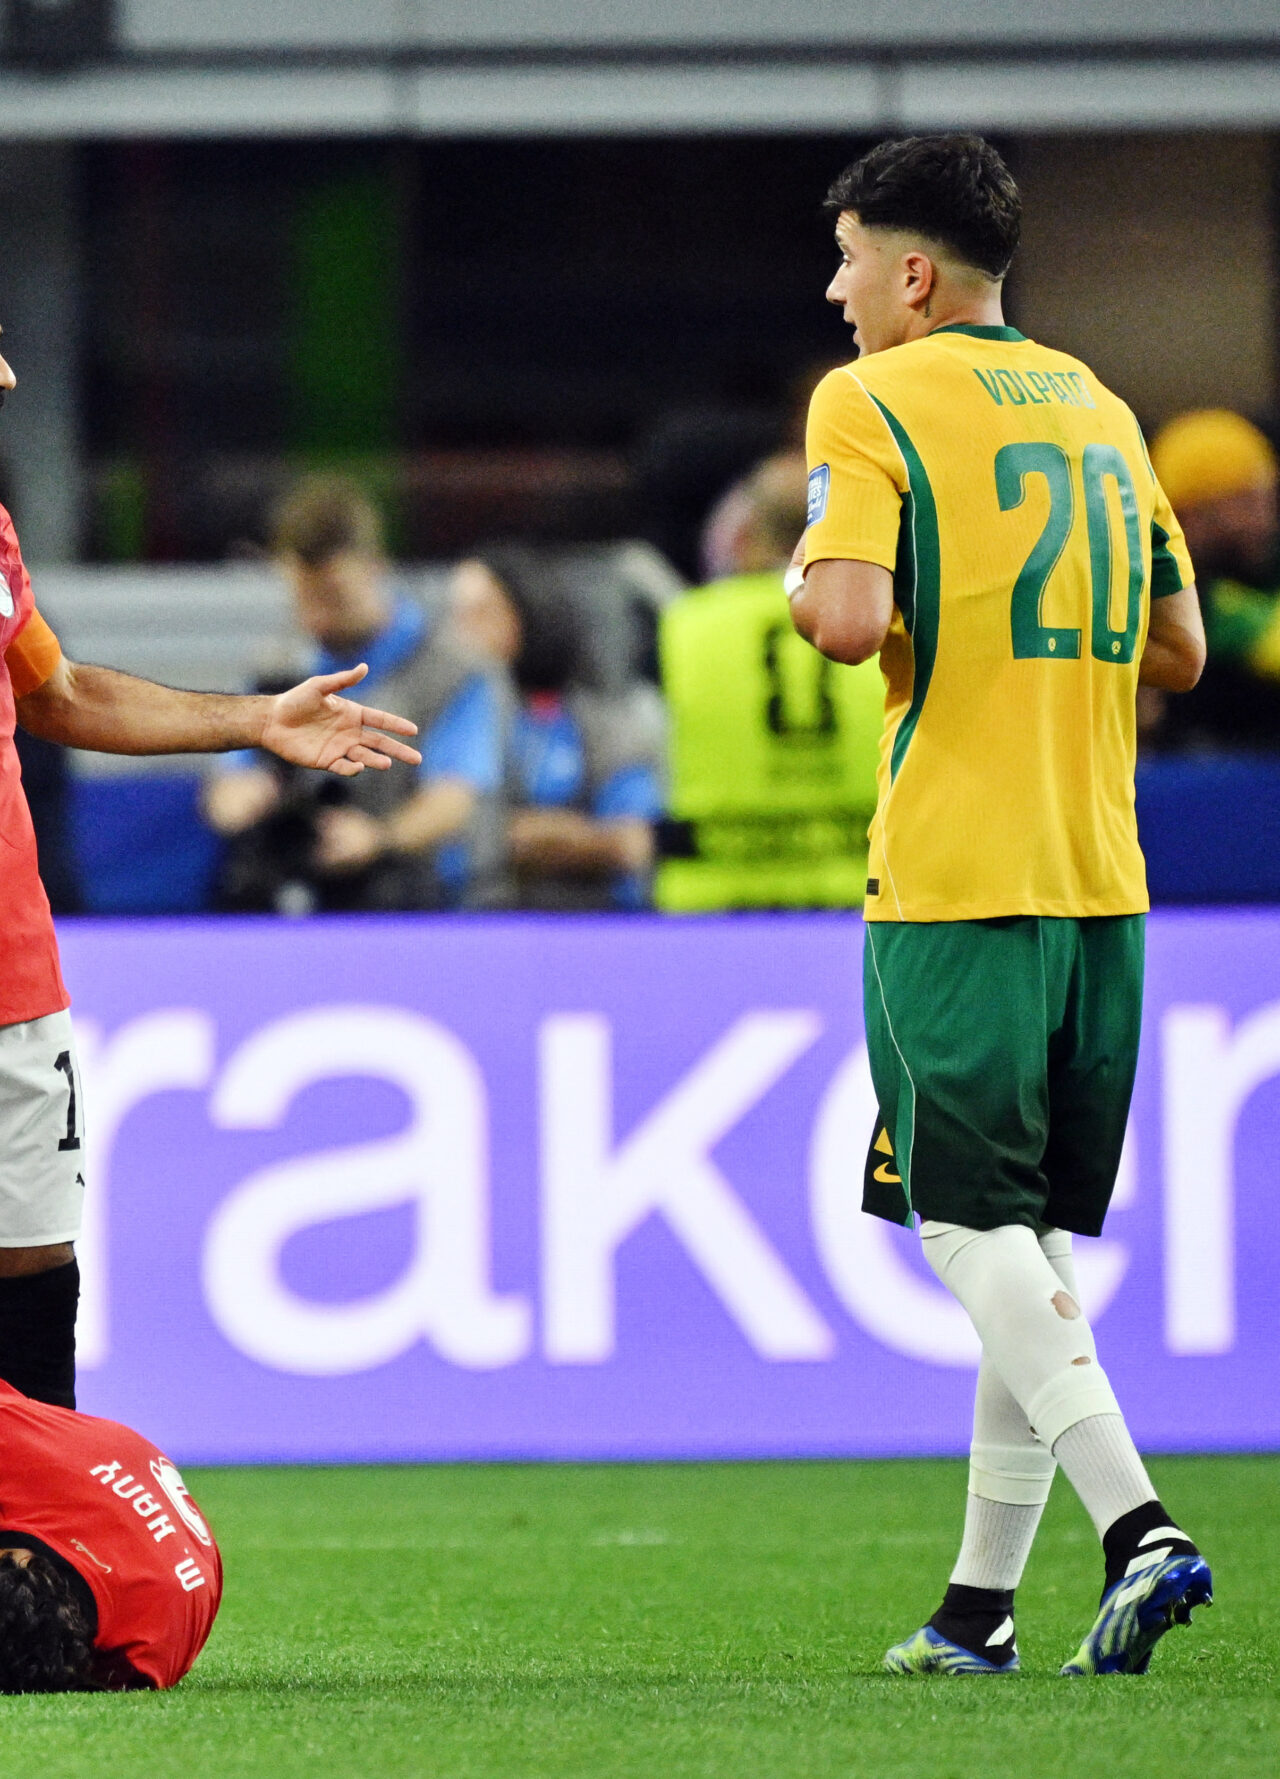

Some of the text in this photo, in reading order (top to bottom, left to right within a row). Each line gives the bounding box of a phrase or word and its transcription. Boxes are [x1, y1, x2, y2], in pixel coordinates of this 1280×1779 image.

[972, 368, 1097, 410] VOLPATO
[994, 441, 1145, 665] 20
[89, 1456, 178, 1544] HANY
[174, 1547, 207, 1592] M.
